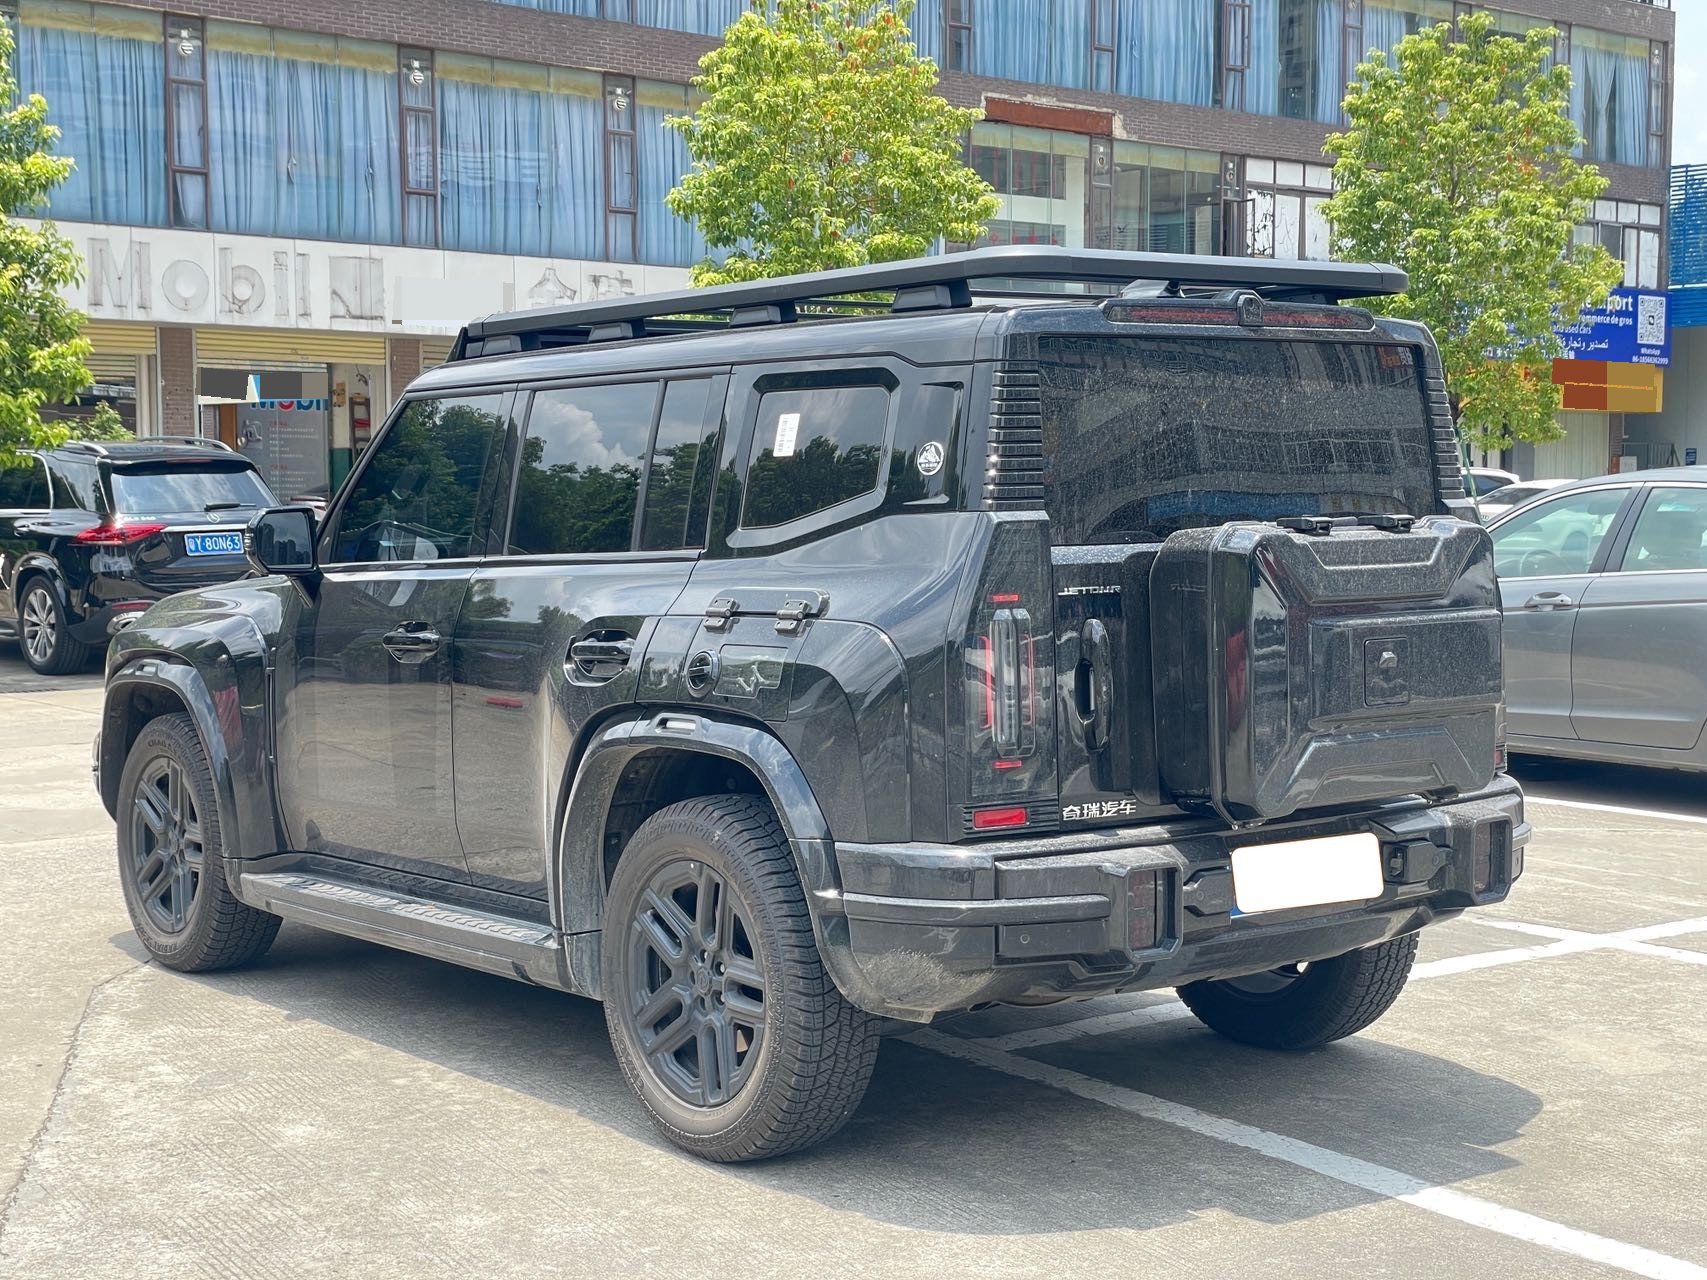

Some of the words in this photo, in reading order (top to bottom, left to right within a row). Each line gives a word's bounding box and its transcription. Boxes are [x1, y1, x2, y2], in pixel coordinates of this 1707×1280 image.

[87, 237, 310, 317] Mobil
[1597, 295, 1633, 314] port
[1610, 315, 1619, 324] de
[1620, 317, 1632, 326] gros
[1062, 799, 1137, 820] 奇瑞汽车
